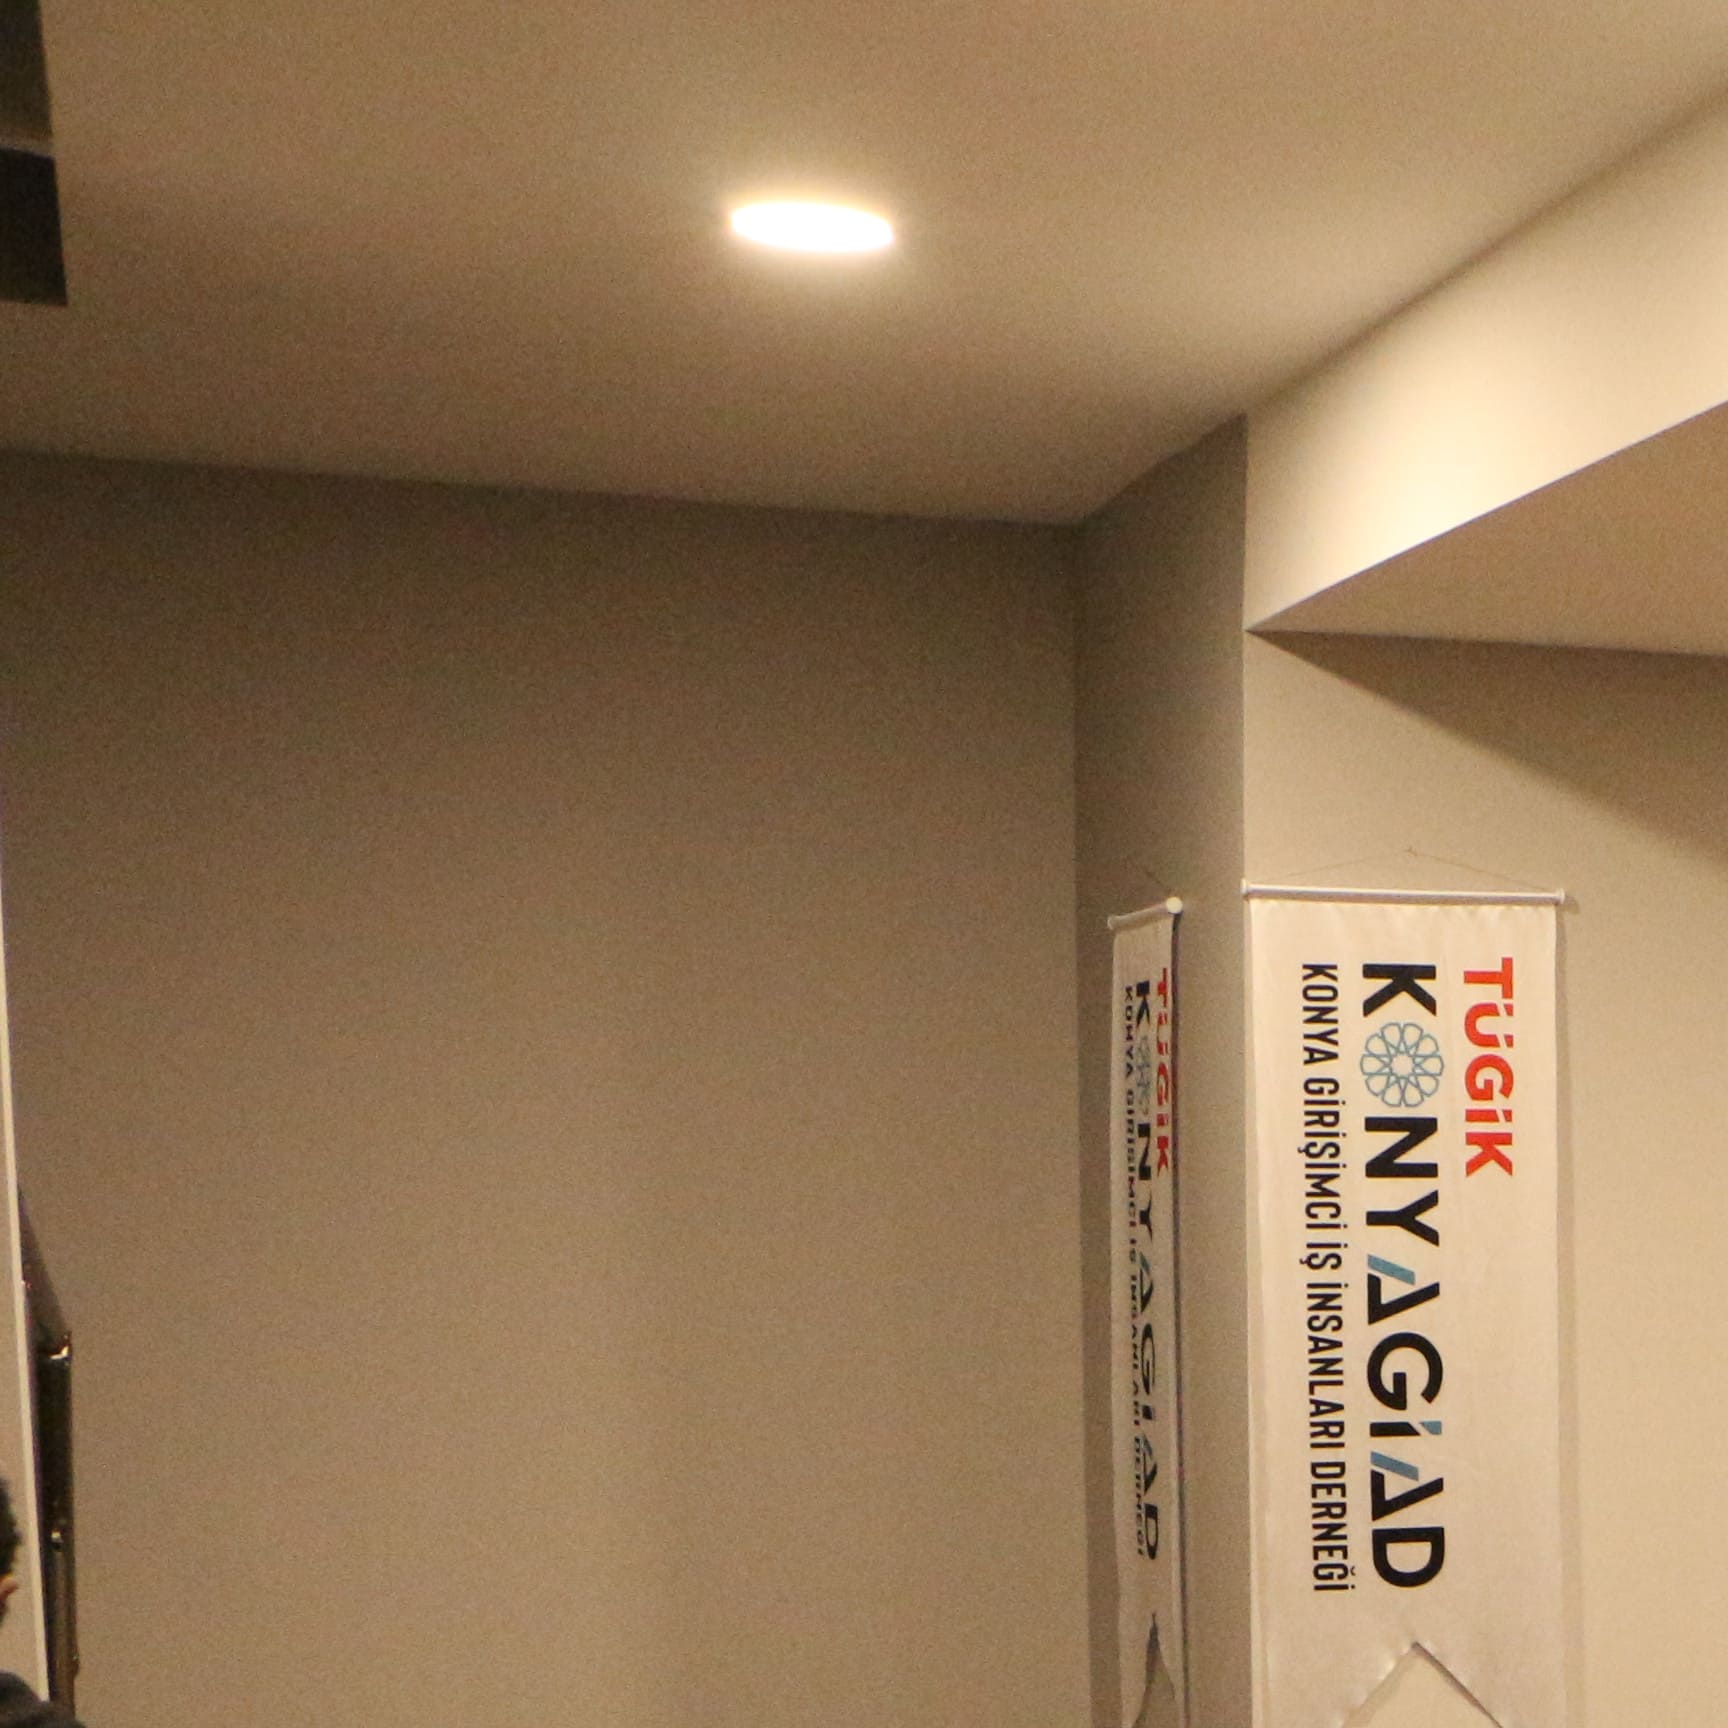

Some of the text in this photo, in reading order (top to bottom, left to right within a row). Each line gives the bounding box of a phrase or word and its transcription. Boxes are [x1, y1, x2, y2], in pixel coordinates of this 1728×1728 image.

[1298, 963, 1355, 1591] KONYA GİRİŞİMCİ İŞ İNSANLARI DERNEĞİ
